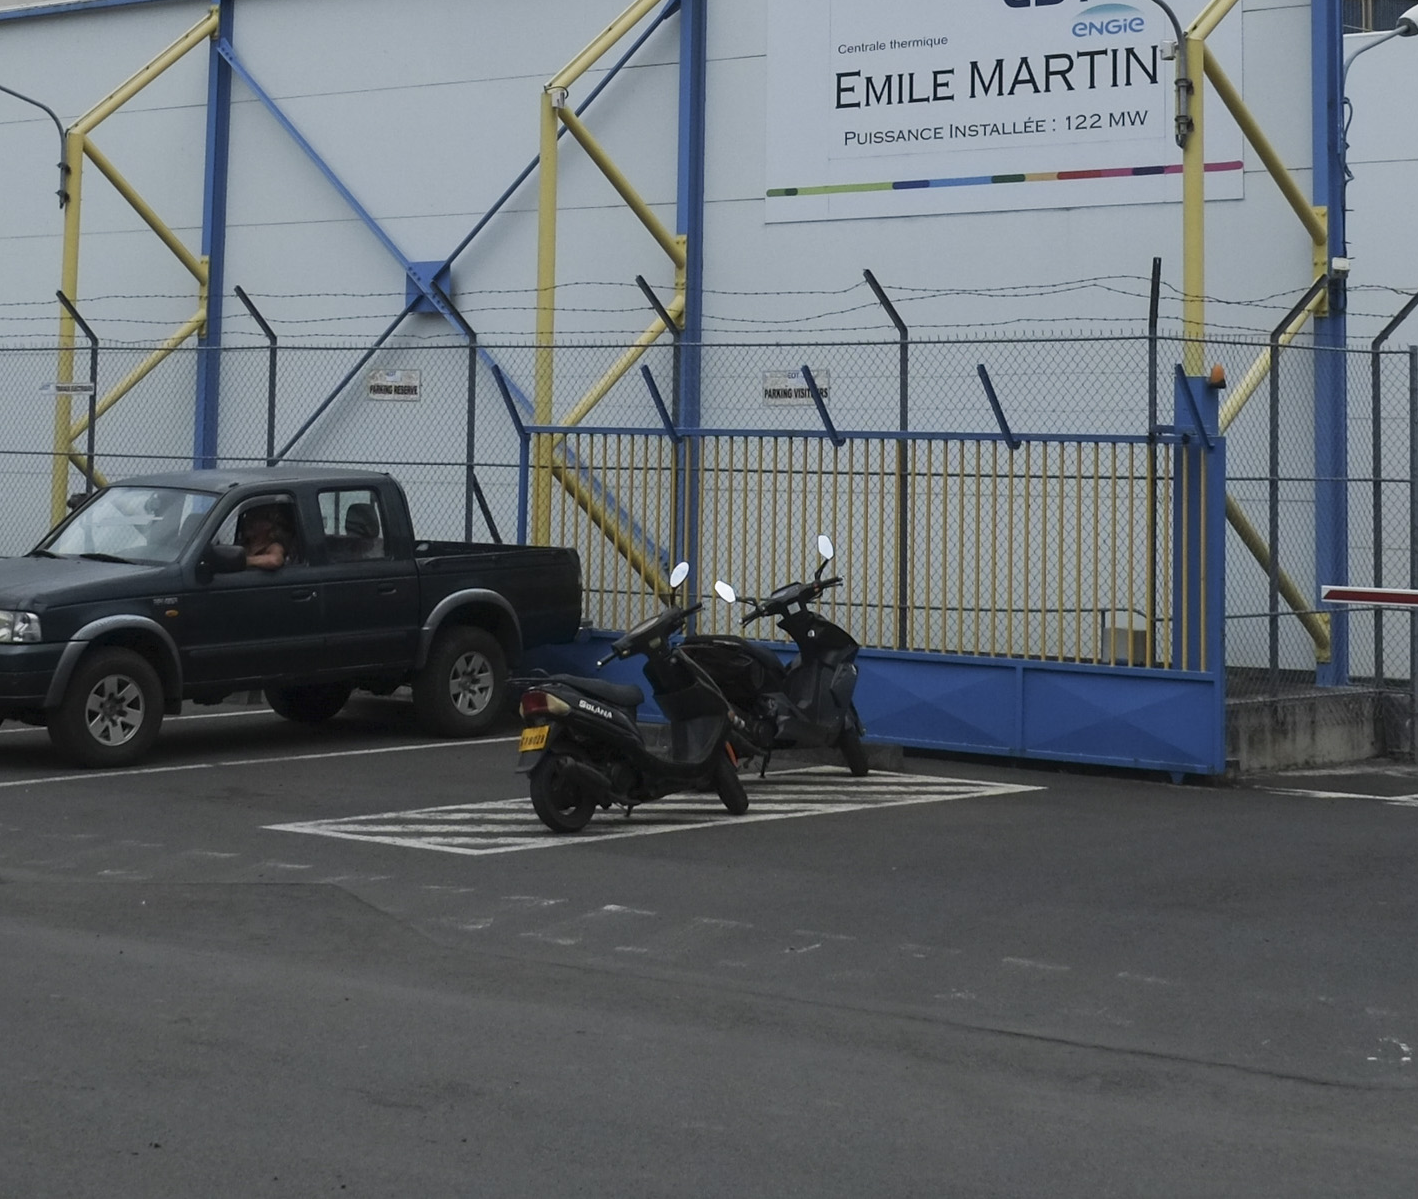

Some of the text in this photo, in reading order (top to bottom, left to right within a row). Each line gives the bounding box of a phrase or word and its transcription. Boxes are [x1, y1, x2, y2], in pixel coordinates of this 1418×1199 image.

[837, 36, 949, 55] Centrale thermique
[835, 45, 1160, 110] EMILE MARTIN
[843, 126, 944, 147] PUISSANCE
[948, 116, 1046, 139] INSTALLÉE
[1065, 114, 1103, 132] 122
[1108, 110, 1149, 128] MW
[764, 388, 829, 399] PARKING VISITRS
